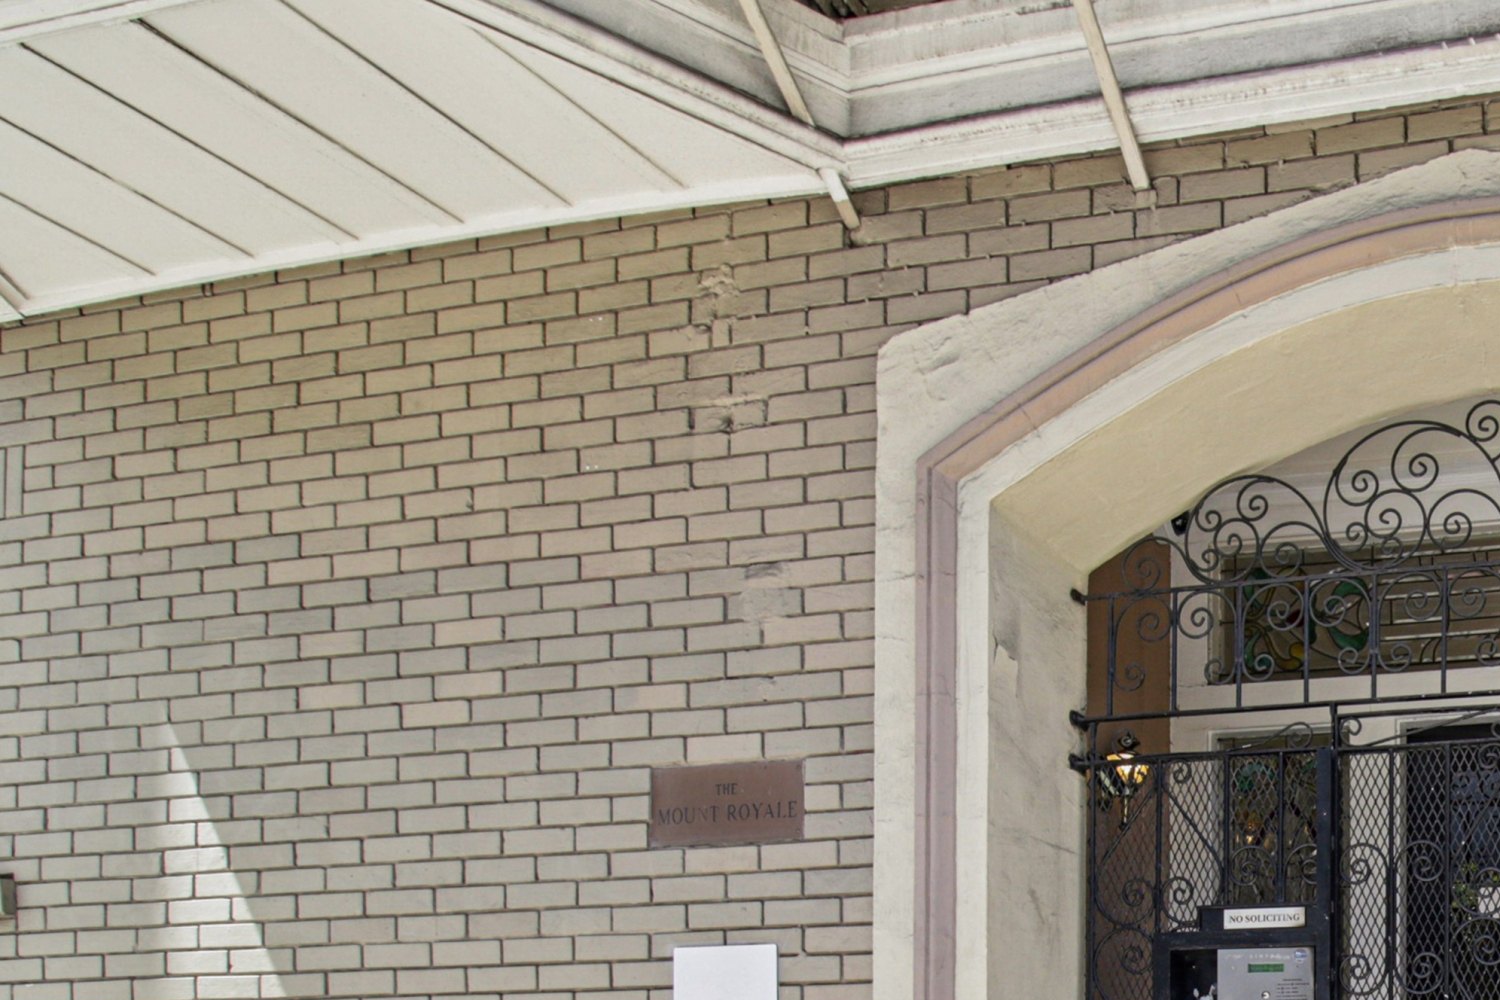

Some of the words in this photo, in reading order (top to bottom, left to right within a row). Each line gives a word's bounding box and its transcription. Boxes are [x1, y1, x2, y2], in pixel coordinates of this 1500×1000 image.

[715, 783, 738, 796] THE
[657, 805, 719, 825] MOUNT
[726, 800, 798, 822] ROYALE
[1229, 914, 1244, 924] NO
[1245, 912, 1301, 923] SOLICITING
